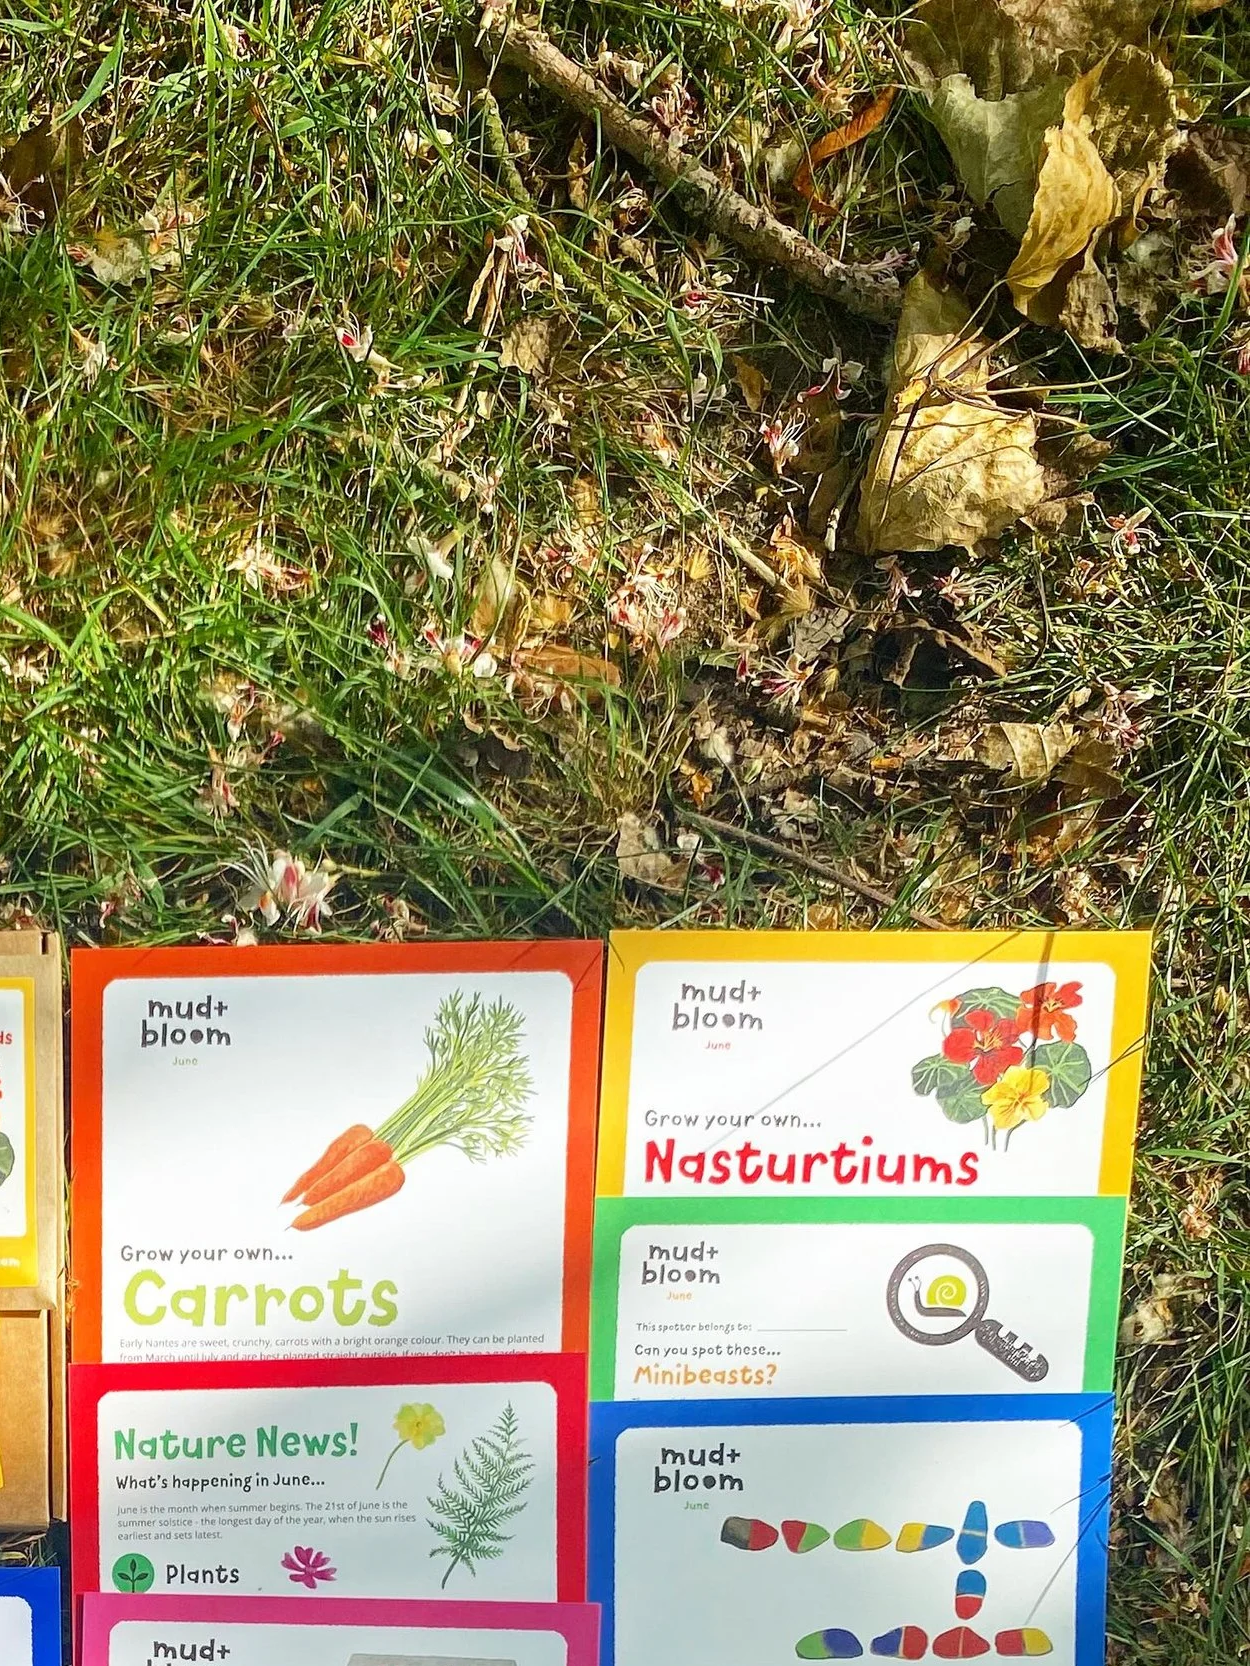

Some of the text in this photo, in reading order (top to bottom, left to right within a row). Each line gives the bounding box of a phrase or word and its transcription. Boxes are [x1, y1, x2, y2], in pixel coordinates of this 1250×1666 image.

[680, 979, 761, 1003] mud+
[147, 994, 228, 1020] mud+
[671, 1002, 763, 1030] bloom
[140, 1020, 231, 1047] bloom
[704, 1040, 731, 1050] June
[171, 1055, 198, 1066] June
[644, 1109, 821, 1130] Grow your own...
[644, 1136, 979, 1185] Nasturtiums
[119, 1244, 293, 1264] Grow your own...
[648, 1240, 719, 1262] mud+
[640, 1261, 720, 1285] bloom
[122, 1269, 399, 1326] Carrots
[665, 1290, 692, 1300] June
[635, 1321, 752, 1335] This spotter belongs to:
[119, 1333, 545, 1349] Early Nantes are sweet, crunchy, carrots with a bright orange colour. They can be planted
[633, 1343, 781, 1358] Can you spot these...
[633, 1362, 777, 1385] Minibeasts?
[113, 1422, 358, 1460] Nature News!
[660, 1442, 741, 1466] mud+
[115, 1471, 325, 1492] What's happening in June...
[652, 1466, 744, 1493] bloom
[116, 1499, 408, 1516] June is the month when summer begins. The 21st of June is the
[683, 1500, 710, 1510] June
[165, 1563, 239, 1584] Plants
[152, 1638, 231, 1661] mud+
